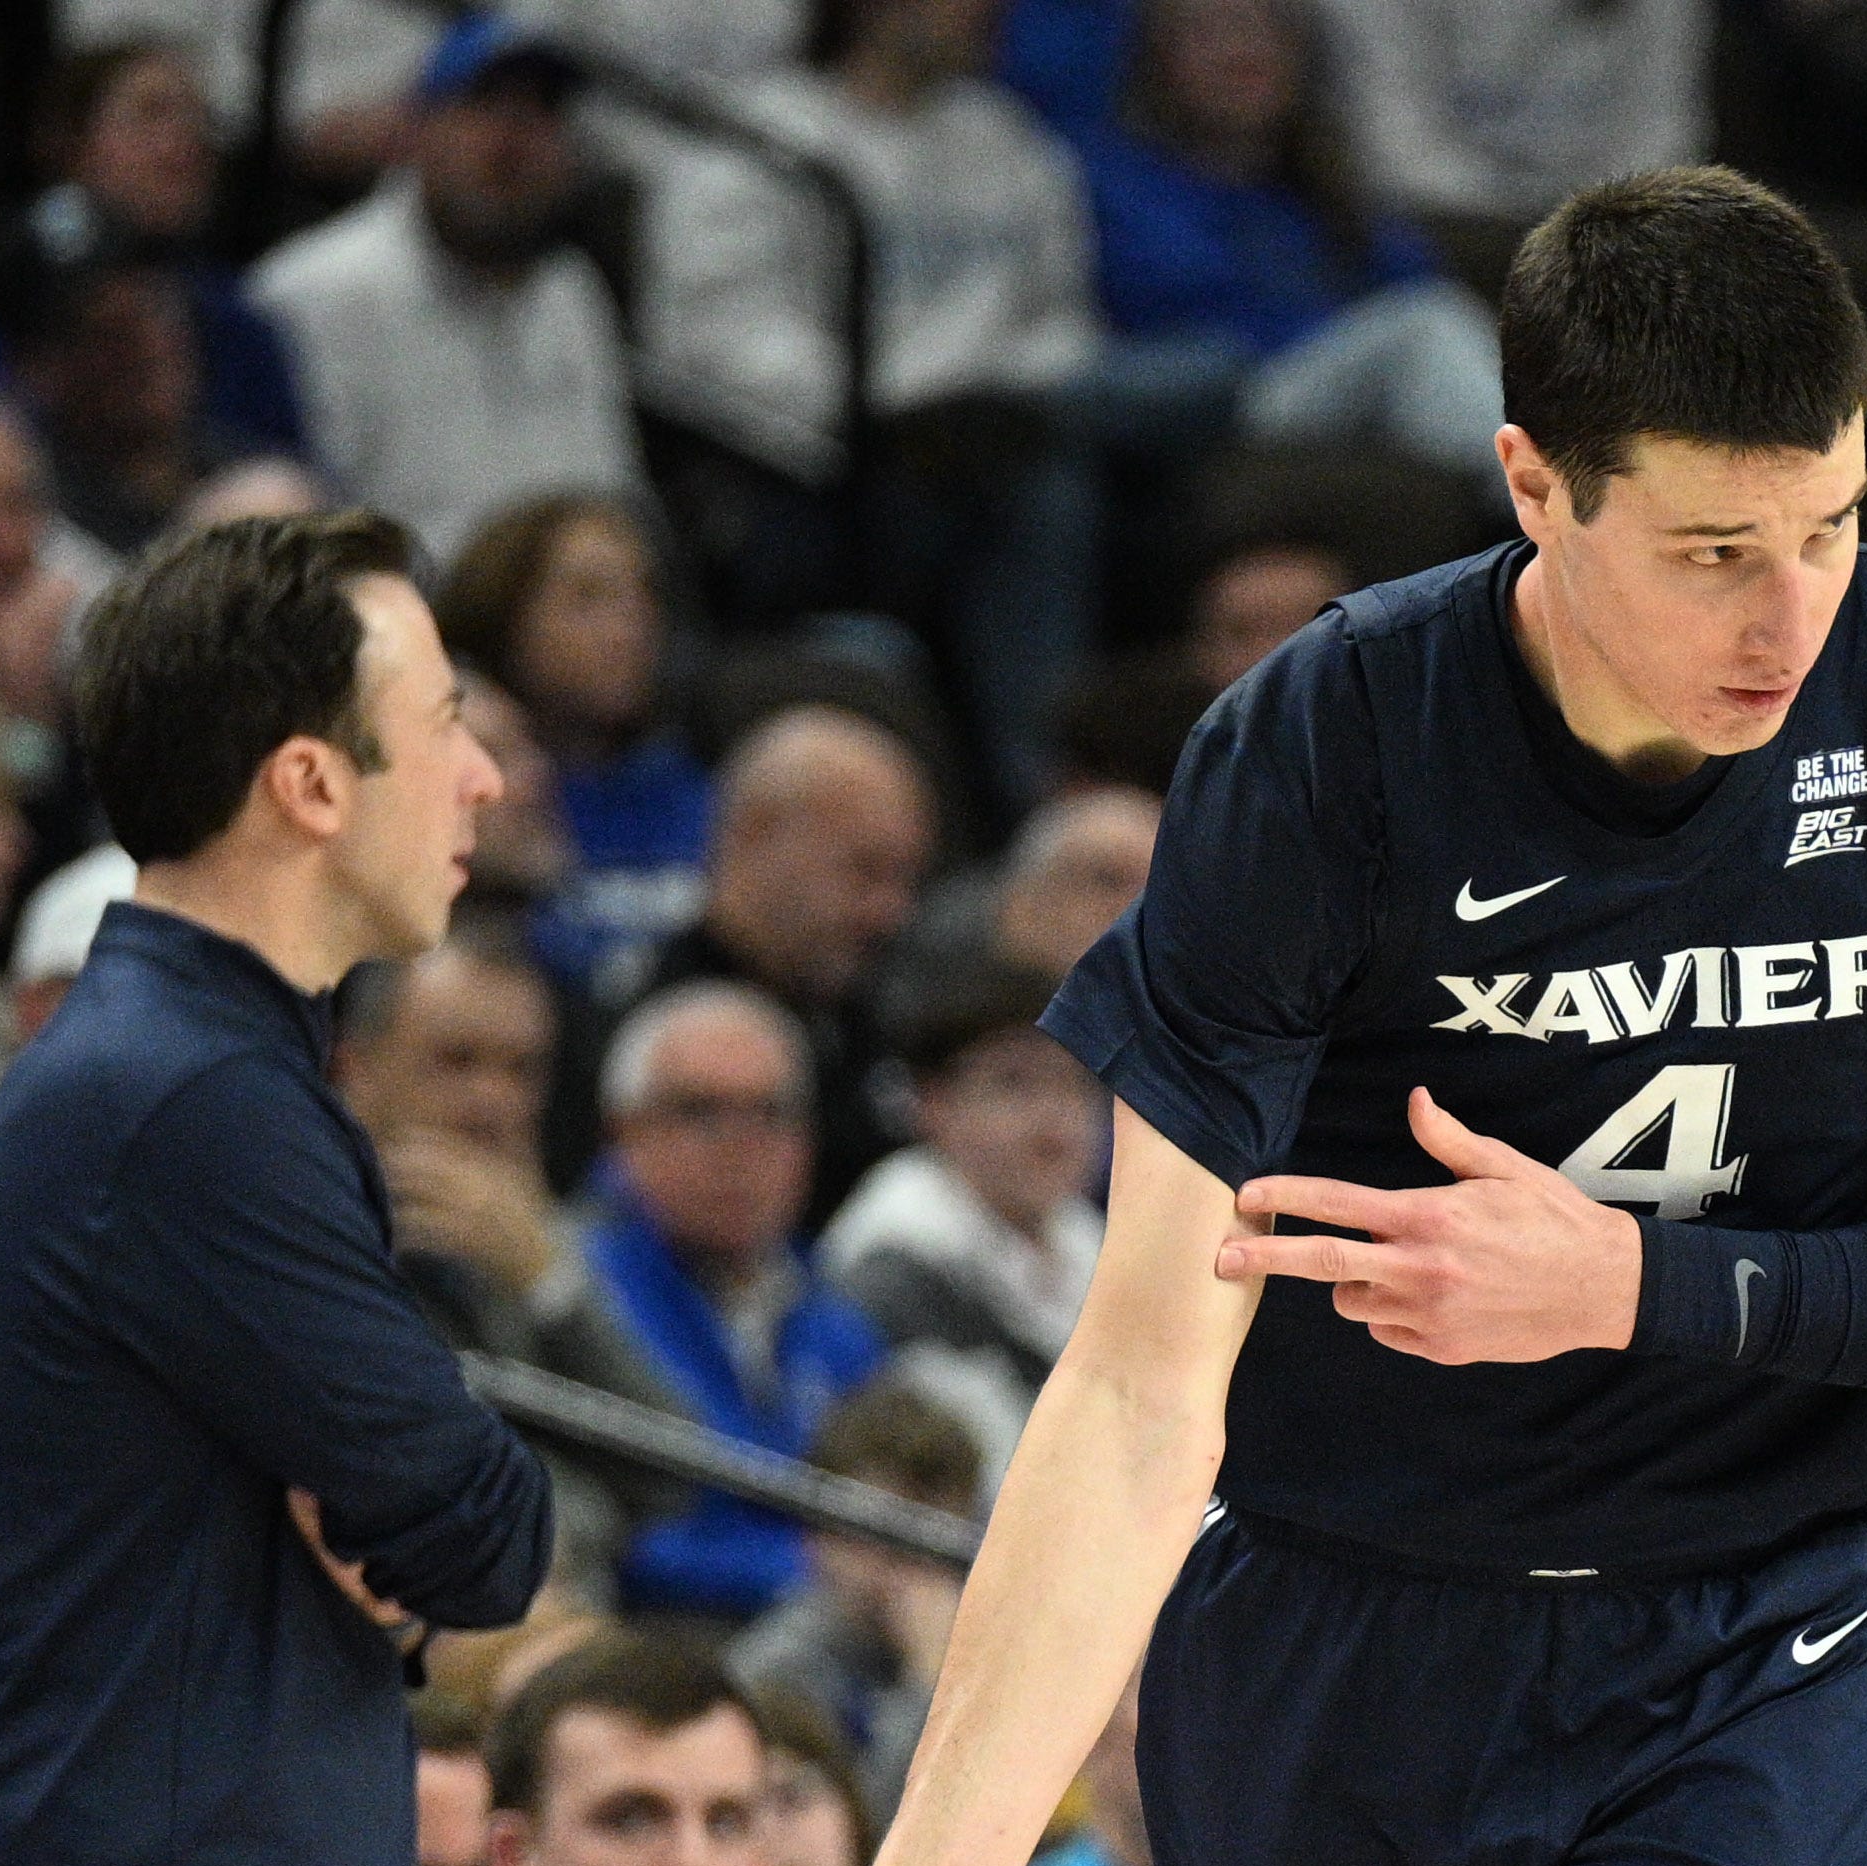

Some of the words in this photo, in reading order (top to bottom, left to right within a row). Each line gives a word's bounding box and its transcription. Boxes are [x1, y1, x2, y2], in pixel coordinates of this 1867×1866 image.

[1797, 756, 1824, 780] BE
[1830, 749, 1865, 774] THE
[1796, 806, 1855, 834] BIG
[1557, 1063, 1749, 1221] 4
